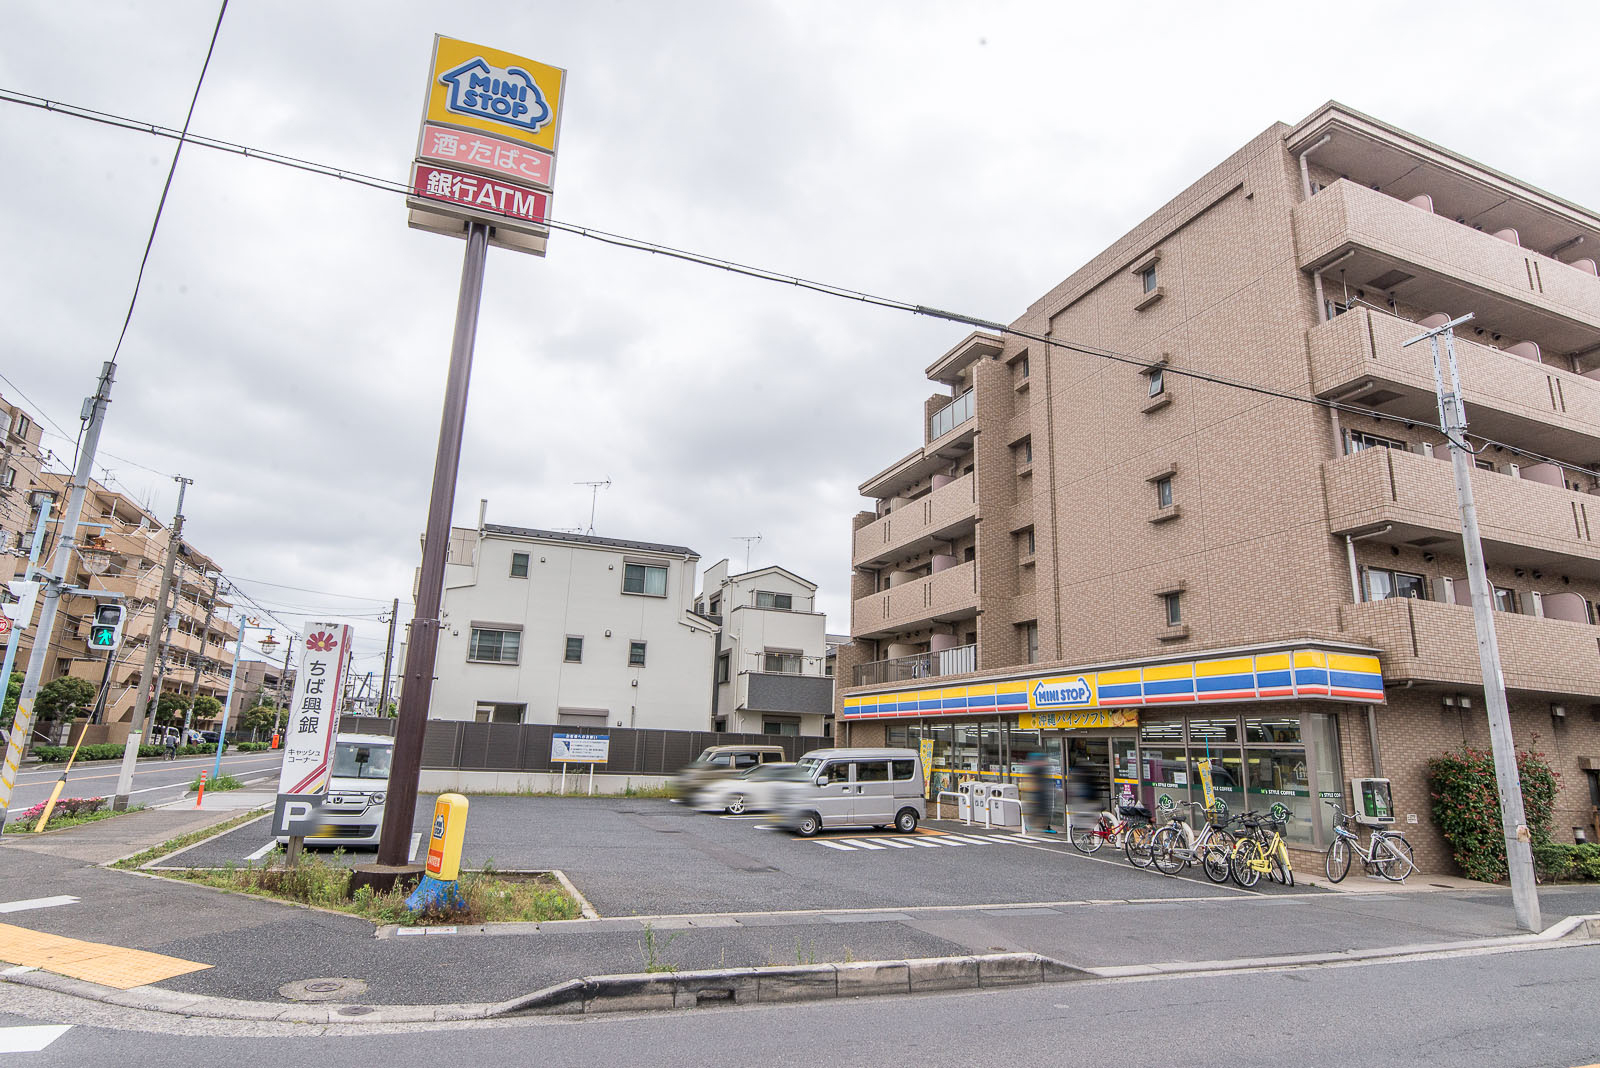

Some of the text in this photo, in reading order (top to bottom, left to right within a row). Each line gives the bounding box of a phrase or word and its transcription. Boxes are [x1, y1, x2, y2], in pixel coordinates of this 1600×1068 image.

[469, 72, 527, 102] MINI
[463, 89, 528, 118] STOP
[432, 132, 541, 177] 酒・たばこ
[426, 170, 535, 219] 銀行ATM
[298, 660, 327, 733] ちば興銀
[1038, 687, 1085, 702] MINI STOP
[288, 748, 320, 757] キャッシュ
[288, 756, 319, 764] コーナー
[281, 801, 313, 830] P
